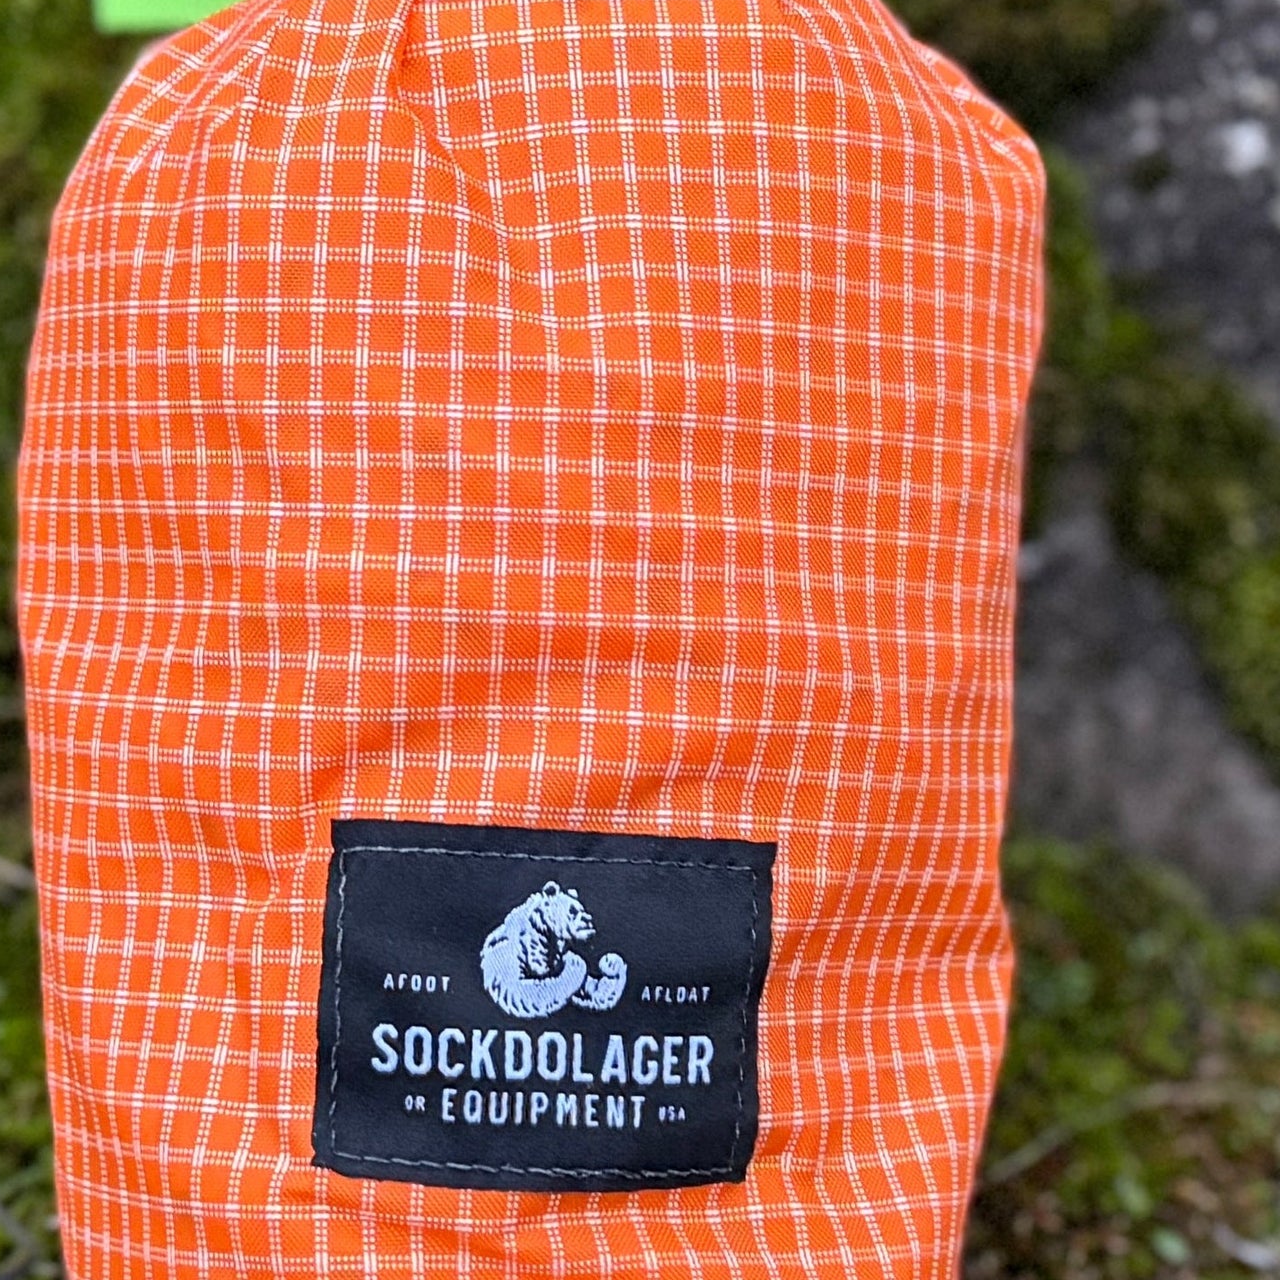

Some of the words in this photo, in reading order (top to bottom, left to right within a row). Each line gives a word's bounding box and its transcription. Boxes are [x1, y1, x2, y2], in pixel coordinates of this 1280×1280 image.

[383, 972, 451, 993] AFOOT
[641, 985, 711, 1003] AFLOAT
[371, 1023, 714, 1085] SOCKDOLAGER
[404, 1094, 426, 1112] OR
[441, 1088, 646, 1129] EQUIPMENT
[658, 1105, 686, 1122] USA
